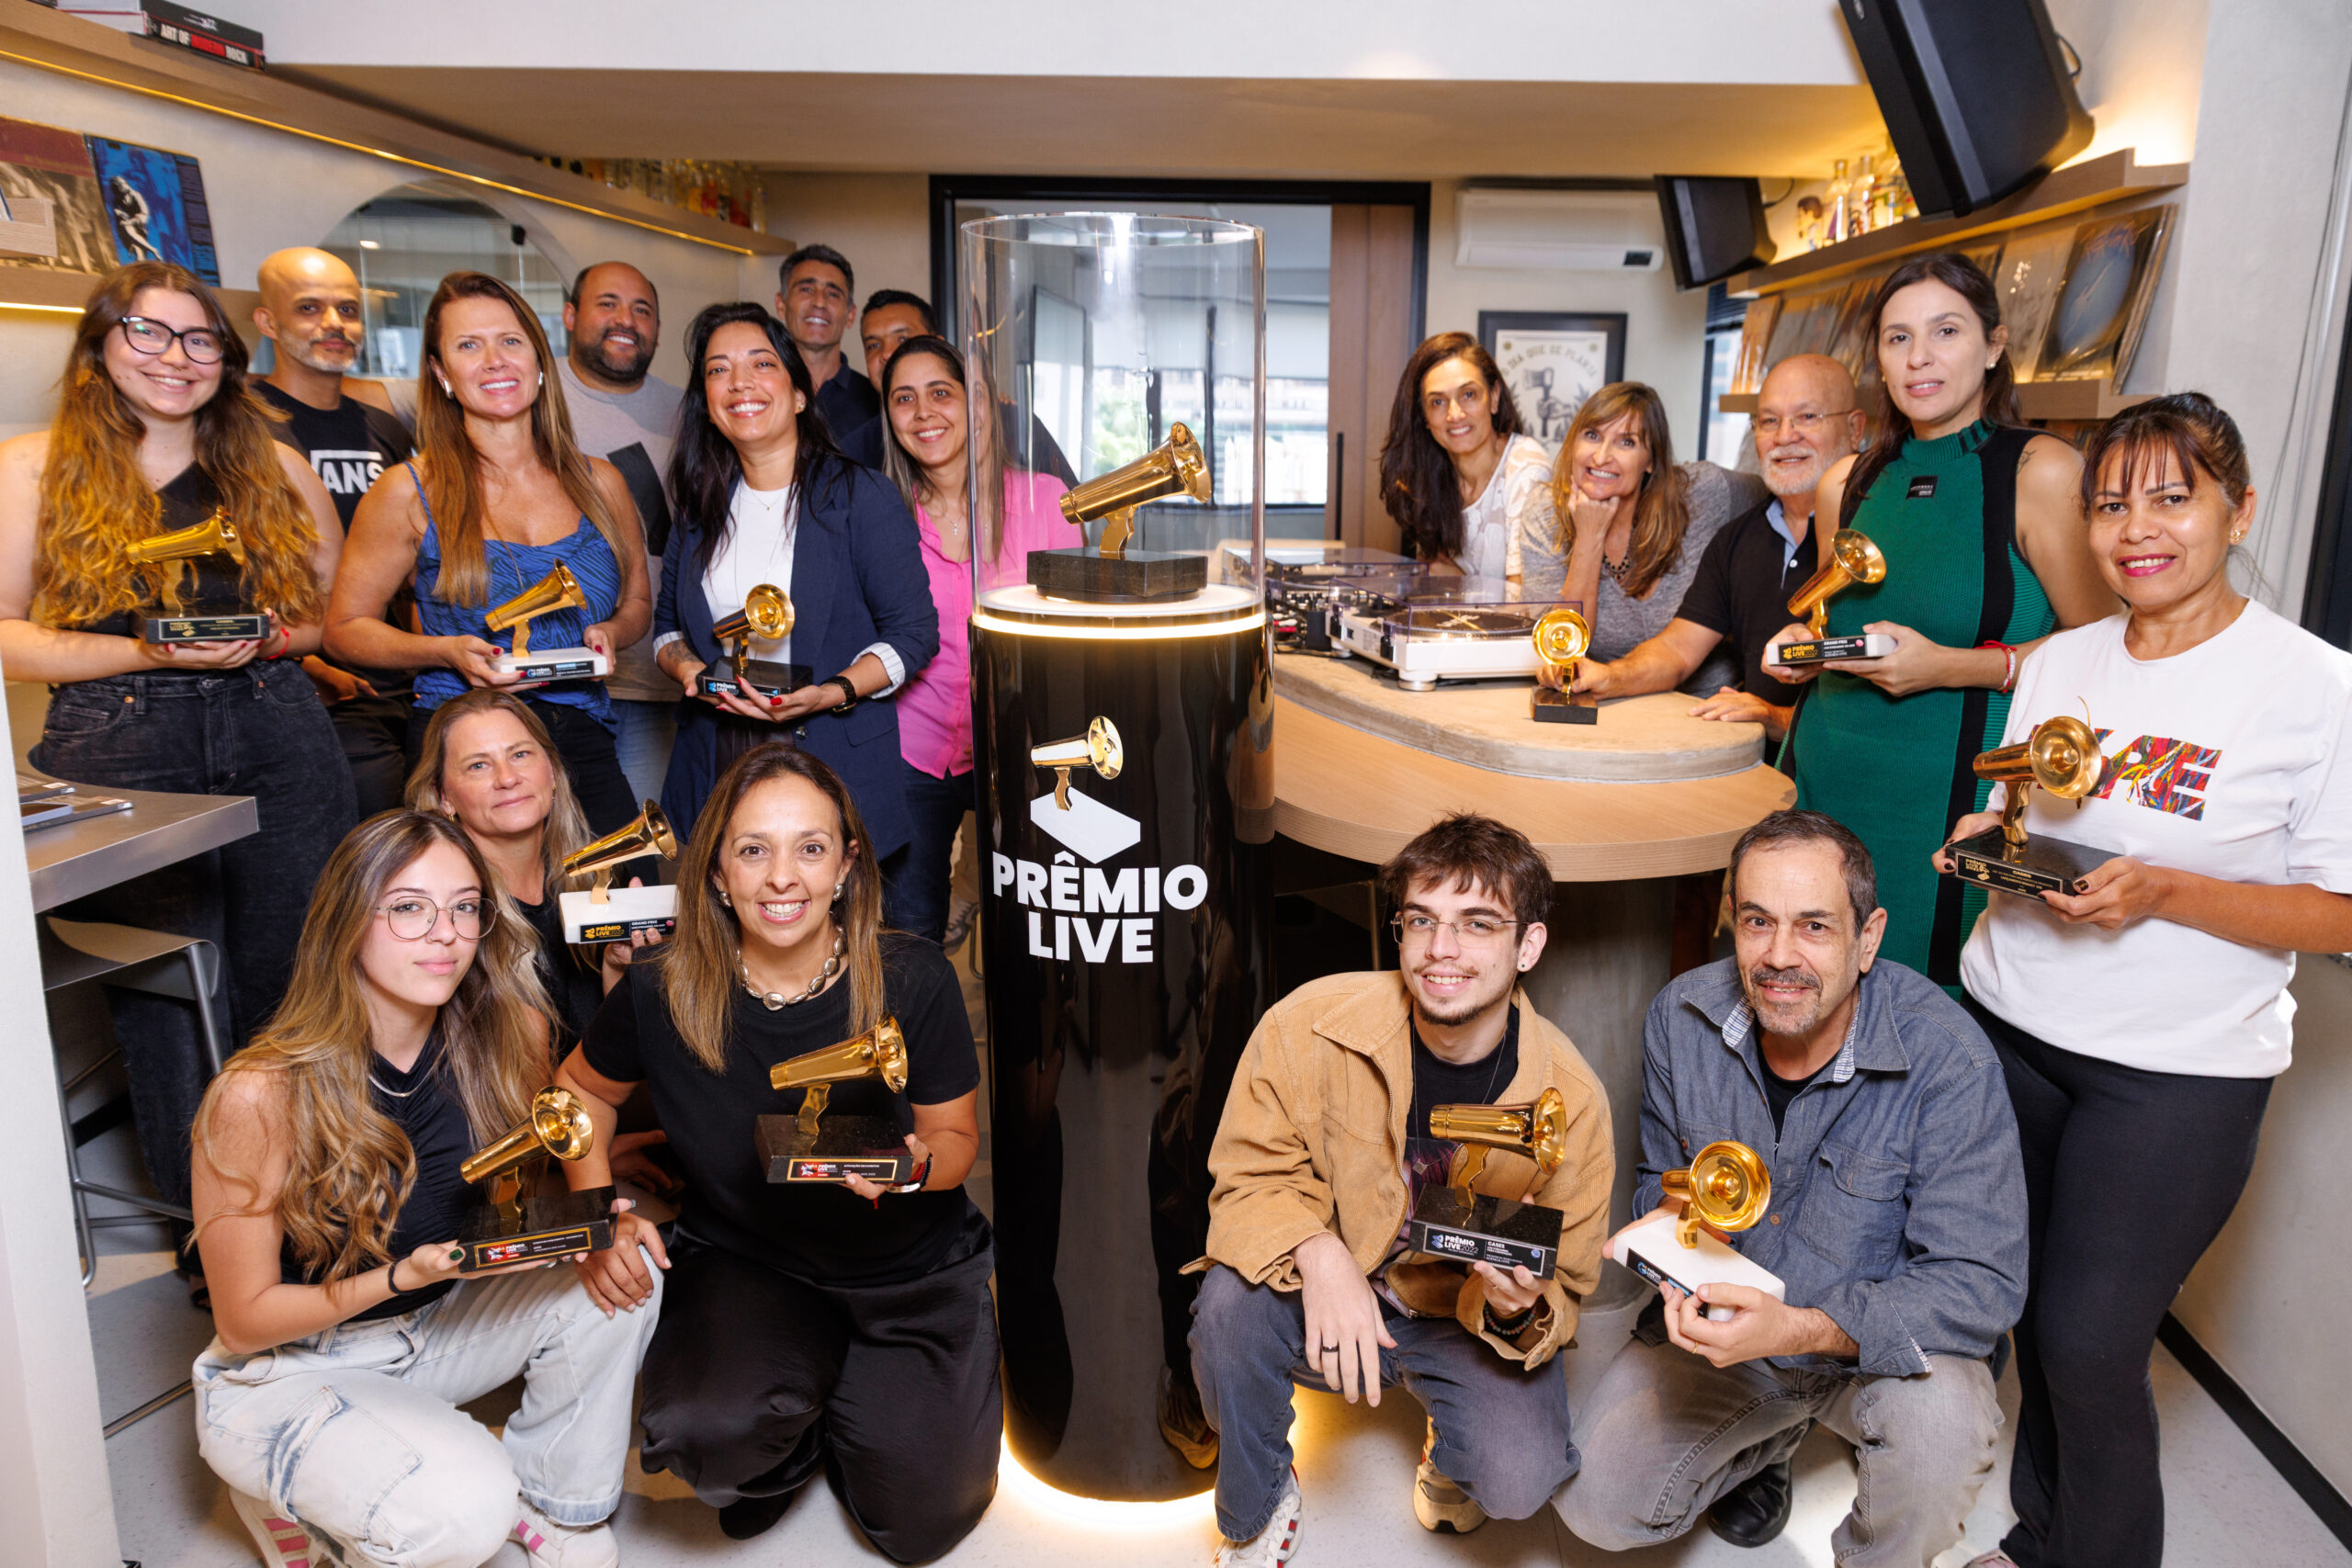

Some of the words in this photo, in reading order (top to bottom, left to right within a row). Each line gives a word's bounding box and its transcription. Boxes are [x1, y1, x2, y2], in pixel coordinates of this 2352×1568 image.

[160, 23, 178, 42] ART
[178, 28, 190, 46] OF
[225, 44, 248, 64] ROCK
[992, 851, 1208, 913] PRÊMIO
[1028, 910, 1154, 964] LIVE
[1444, 1235, 1476, 1247] PRÊMIO
[1487, 1241, 1505, 1249] CASES
